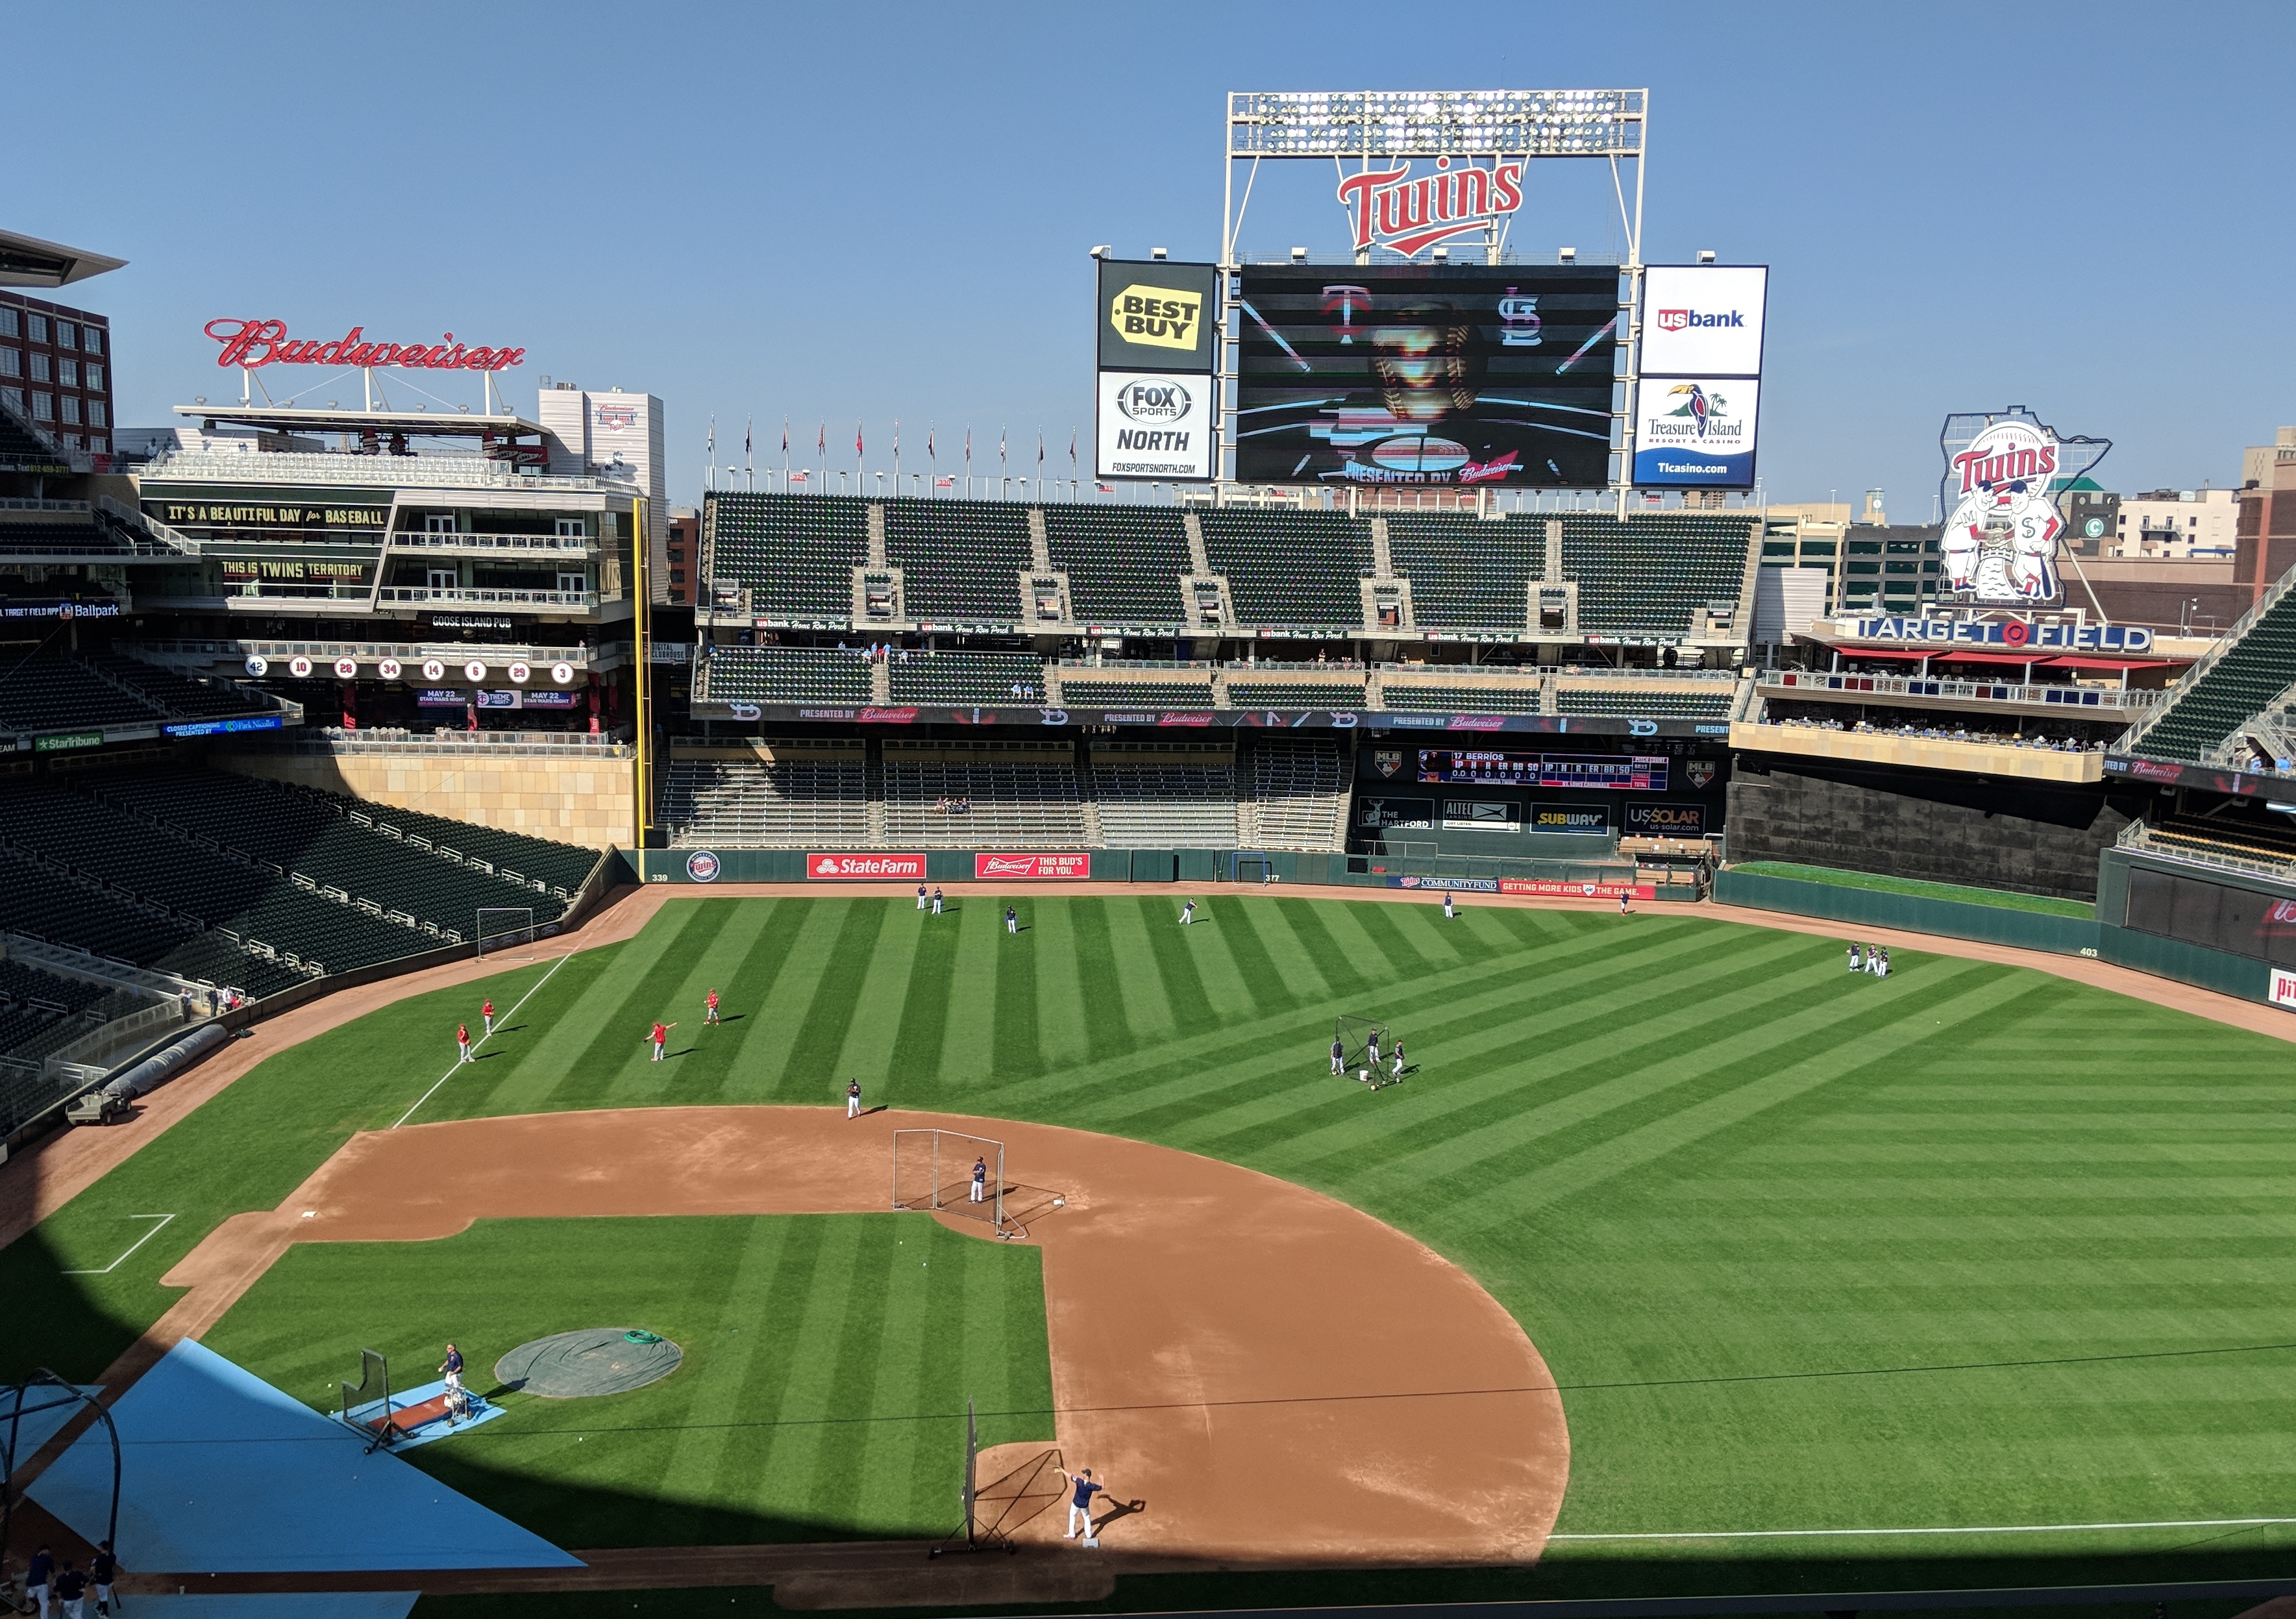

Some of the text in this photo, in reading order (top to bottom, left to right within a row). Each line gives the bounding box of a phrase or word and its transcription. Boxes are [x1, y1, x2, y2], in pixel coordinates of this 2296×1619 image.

[1337, 156, 1523, 251] Twins
[1123, 295, 1198, 321] BEST
[1125, 315, 1191, 340] BUY
[204, 319, 525, 370] Budweiser
[1133, 387, 1176, 407] FOX
[1648, 419, 1742, 436] Treasure Island
[1117, 429, 1190, 451] NORTH
[1113, 462, 1195, 474] FOXSPORTSNORTH.COM
[1459, 462, 1511, 482] Budweiser
[1954, 443, 2055, 493] Twins
[168, 506, 384, 525] IT'S A BEAUTIFUL DAY for BASEBALL
[222, 561, 362, 578] THIS IS TWINS TERRITORY
[47, 608, 59, 616] APP
[75, 604, 119, 618] Ballpark
[432, 616, 512, 628] GOOSE ISLAND PUB
[791, 620, 847, 630] Home Run Porch
[955, 624, 1009, 634] Home Run Porch
[1122, 627, 1141, 636] Home
[1157, 628, 1176, 637] Porch
[1858, 617, 2151, 650] TARGET FIELD
[1326, 631, 1343, 639] Porch
[1460, 634, 1478, 642] Home
[1495, 635, 1513, 643] Porch
[1658, 638, 1677, 647] Porch
[250, 662, 262, 671] 42
[296, 662, 306, 671] 10
[339, 663, 352, 673] 28
[384, 664, 397, 674] 34
[428, 665, 439, 675] 14
[473, 667, 479, 676] 6
[513, 668, 525, 677] 29
[560, 669, 566, 678] 3
[800, 710, 843, 718] PRESENTED
[860, 708, 915, 719] Budweiser
[1161, 712, 1213, 723] Budweiser
[253, 720, 275, 728] Nicollet
[1394, 717, 1433, 725] PRESENTED
[1450, 716, 1503, 727] Budweiser
[175, 728, 204, 737] PRESENTED
[49, 737, 100, 748] StarTribune
[2119, 761, 2127, 771] BY
[2132, 760, 2181, 778] Budweiser
[1447, 802, 1472, 815] ALTEC
[1381, 819, 1429, 828] HARTFORD
[1537, 813, 1602, 825] SUBWAY
[690, 860, 716, 872] Twins
[987, 861, 1031, 870] Budweiser
[1039, 857, 1083, 865] THIS BUD'S
[1039, 866, 1074, 874] FOR YOU.
[1400, 876, 1420, 887] Twins
[1421, 878, 1474, 888] COMMUNITY
[1503, 882, 1536, 891] GETTING
[1538, 884, 1561, 892] MORE
[2080, 948, 2097, 958] 403
